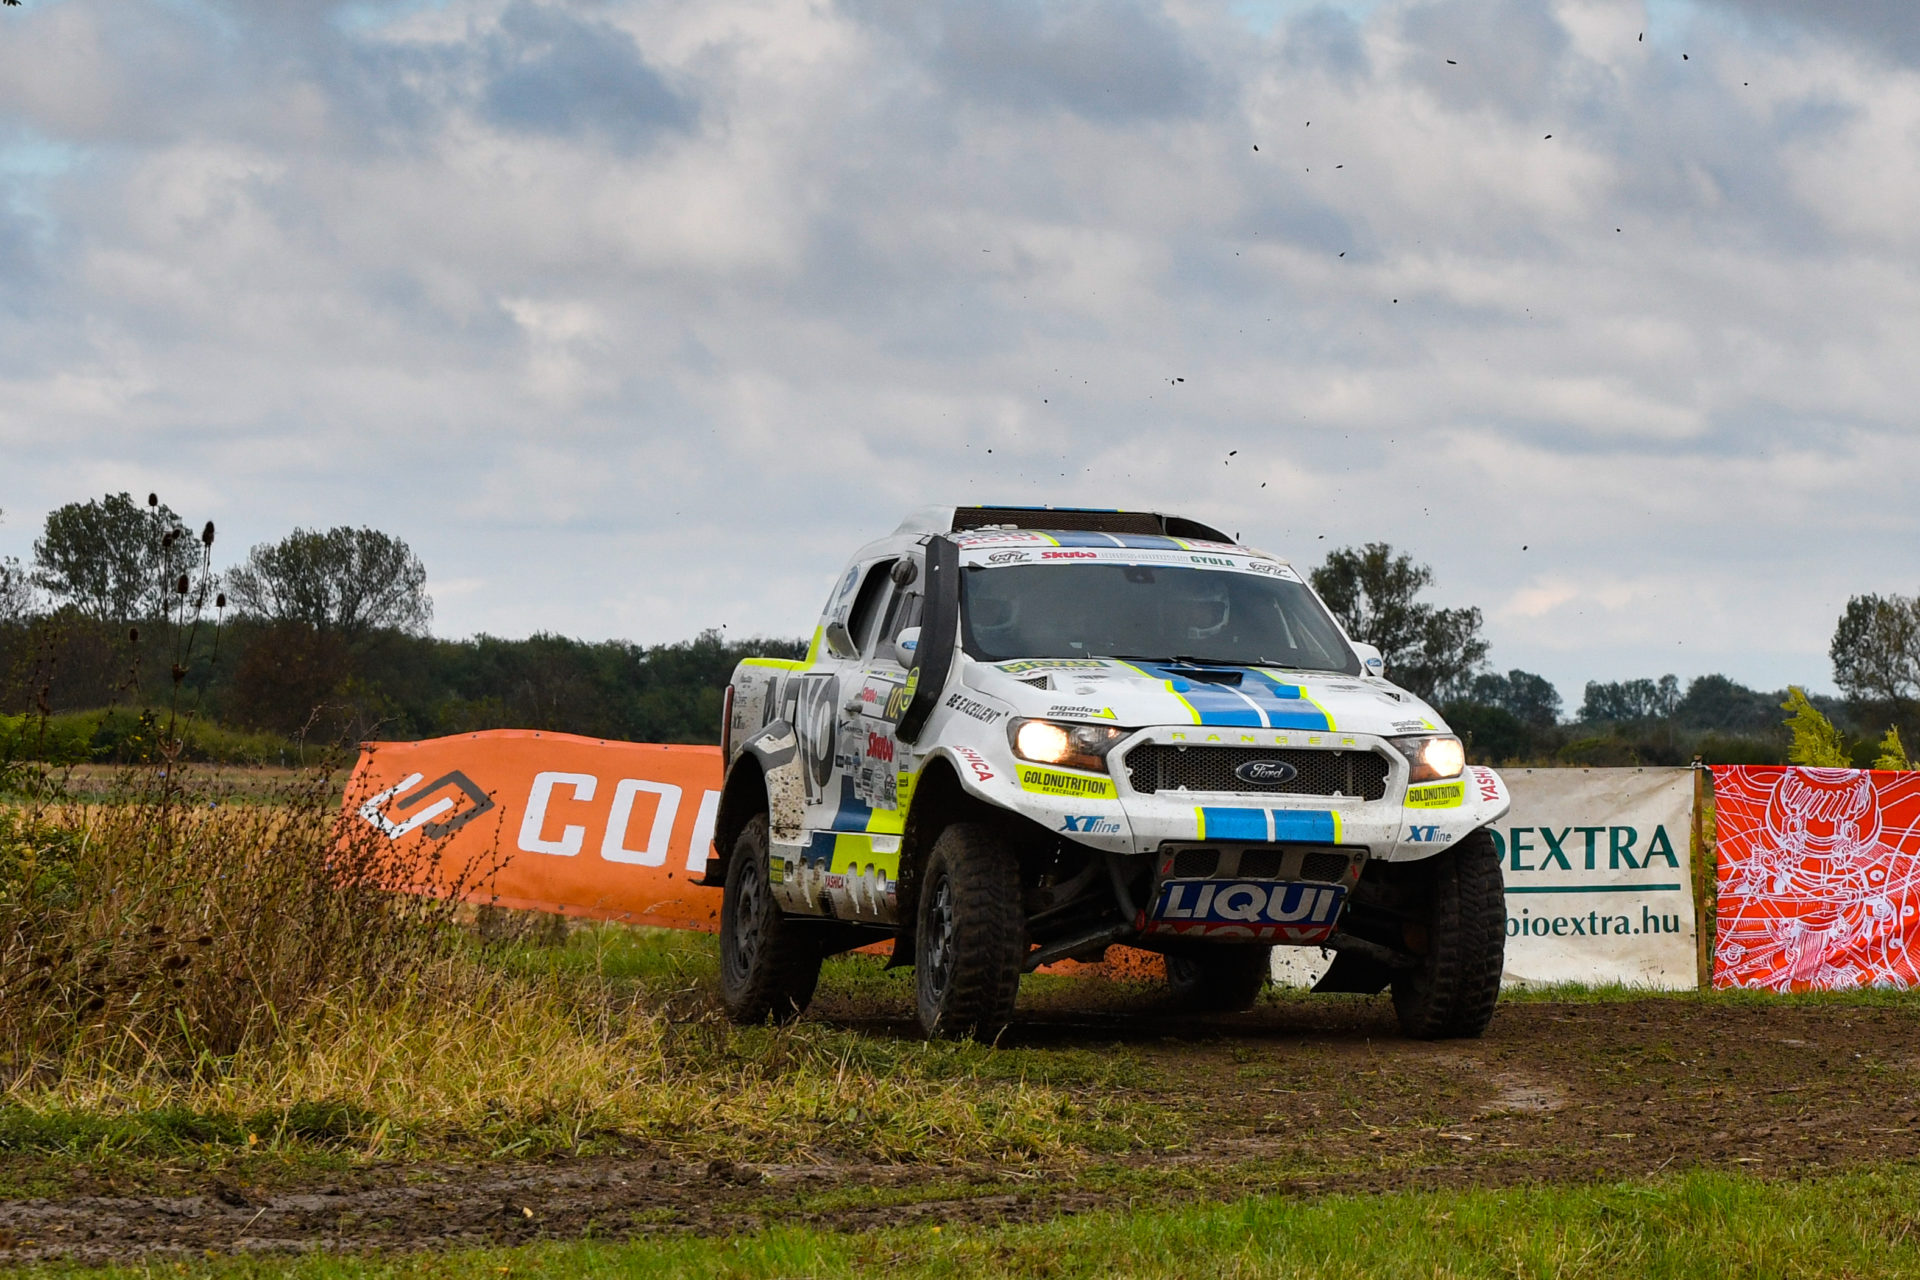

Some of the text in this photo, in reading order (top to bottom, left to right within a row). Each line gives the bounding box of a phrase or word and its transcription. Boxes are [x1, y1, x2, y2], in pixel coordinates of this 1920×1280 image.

[1190, 555, 1234, 567] GYULA
[945, 693, 1001, 725] BE EXCELLENT
[1050, 705, 1101, 714] agados
[1172, 732, 1356, 746] RANGER
[1250, 763, 1284, 778] Ford
[1023, 770, 1107, 795] GOLDNUTRITION
[1409, 785, 1461, 803] GOLDNUTRITION
[1163, 884, 1336, 923] LIQUI
